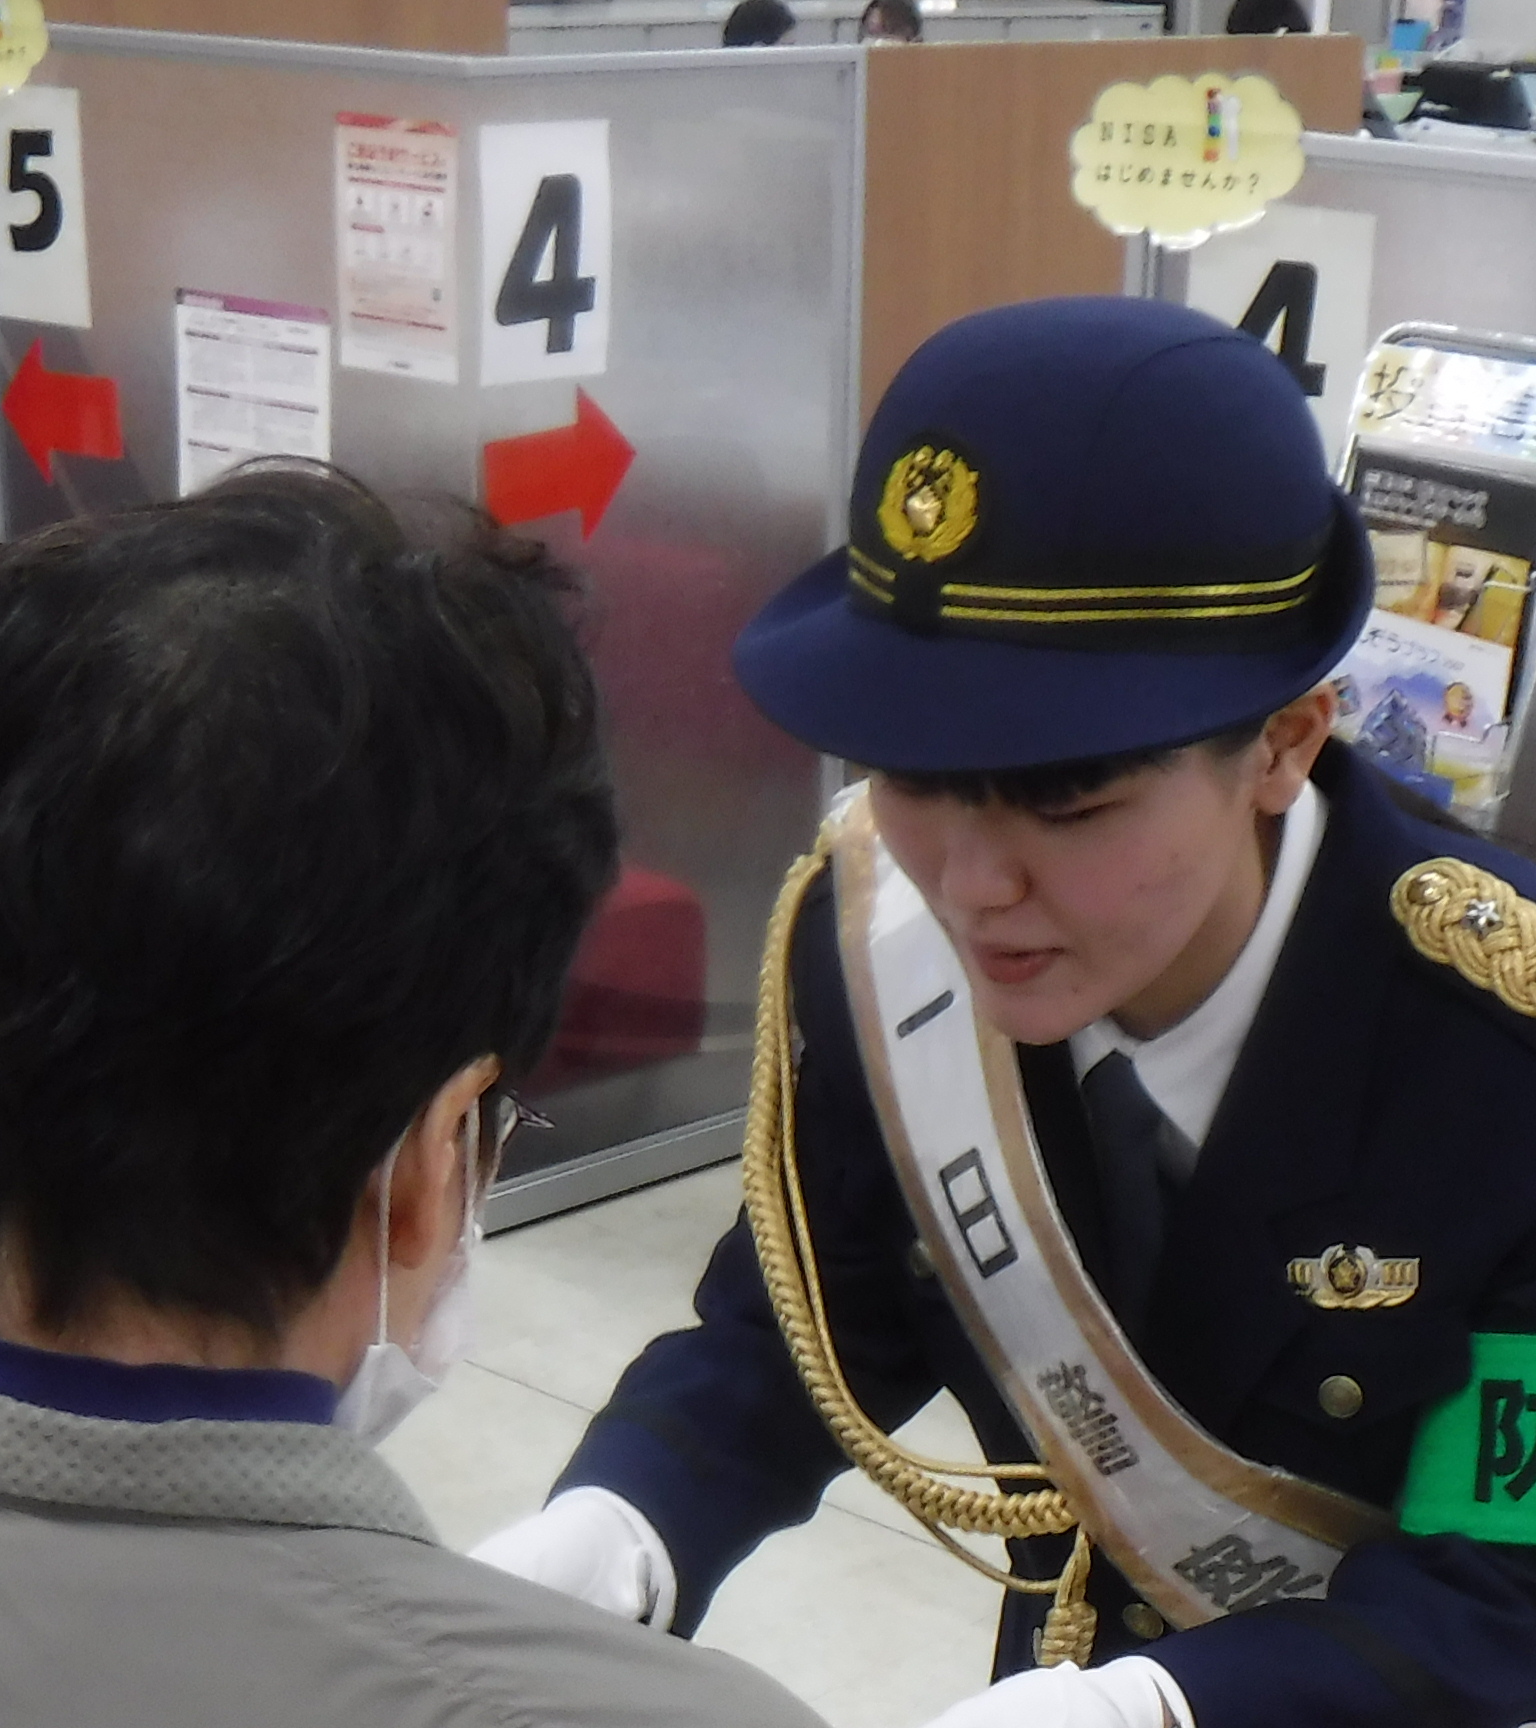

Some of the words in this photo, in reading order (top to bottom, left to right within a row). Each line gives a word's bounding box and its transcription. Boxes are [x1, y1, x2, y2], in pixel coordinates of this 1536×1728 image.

[8, 129, 64, 252] 5
[1100, 121, 1178, 147] NISA
[495, 173, 597, 354] 4
